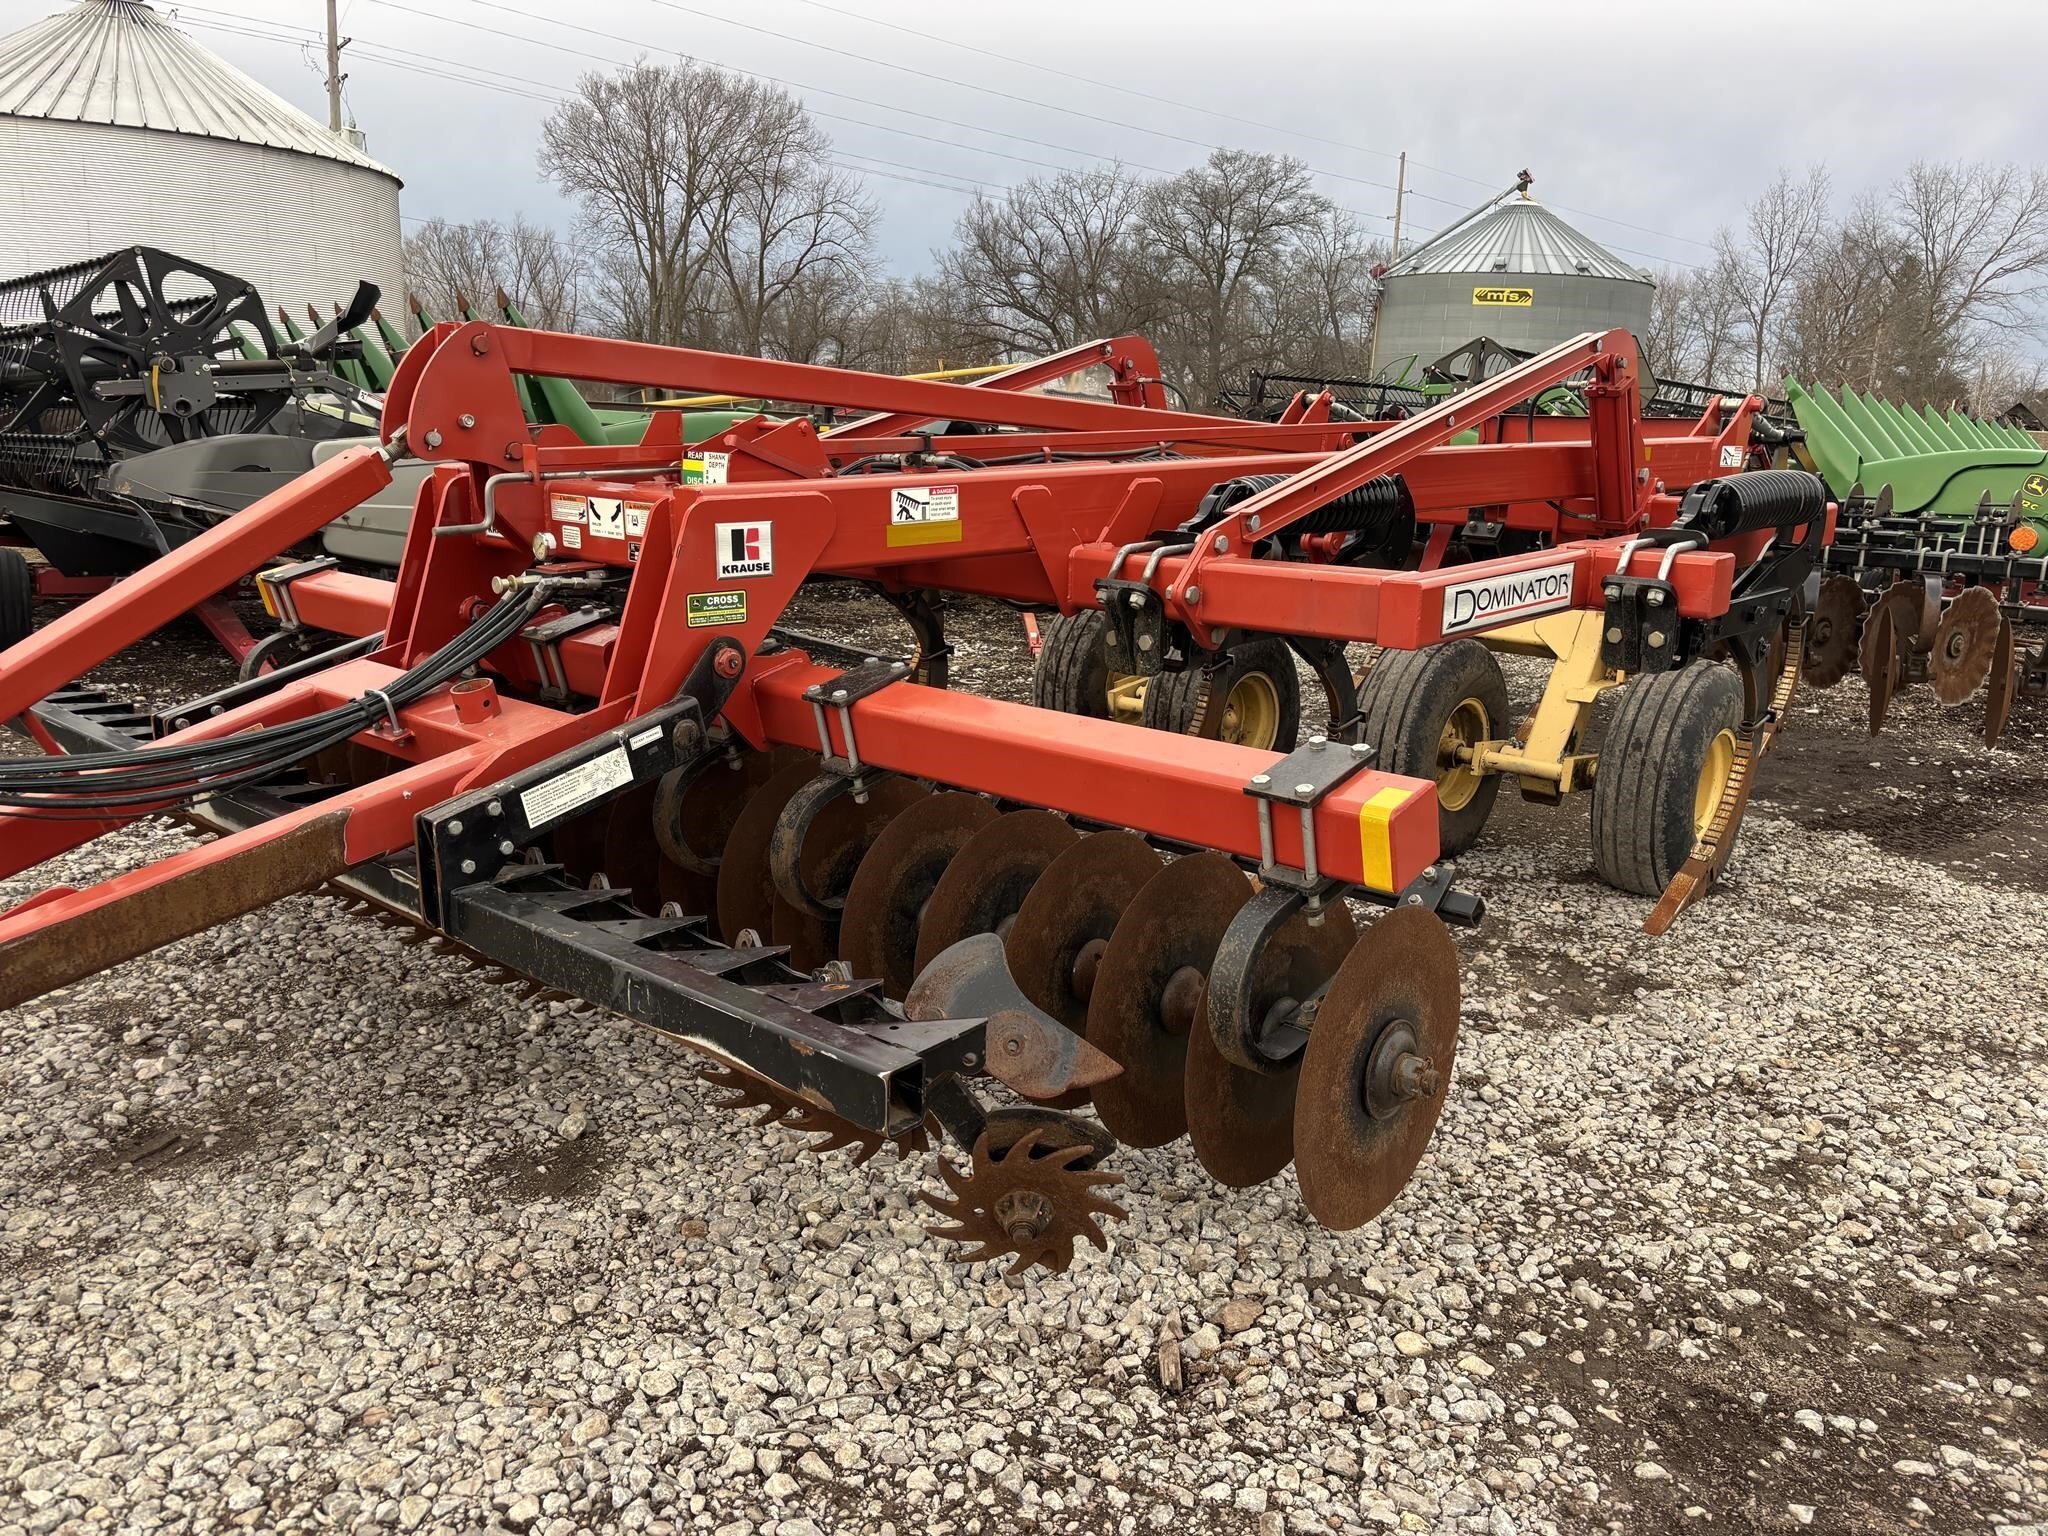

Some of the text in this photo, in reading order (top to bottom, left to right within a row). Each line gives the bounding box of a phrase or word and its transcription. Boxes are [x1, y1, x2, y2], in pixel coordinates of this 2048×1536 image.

[1487, 289, 1520, 304] mfs
[687, 451, 704, 460] REAR
[709, 461, 725, 469] DEPTH
[686, 476, 704, 485] DISC
[722, 562, 770, 574] KRAUSE
[707, 595, 739, 605] CROSS
[1446, 573, 1568, 630] DOMINATOR
